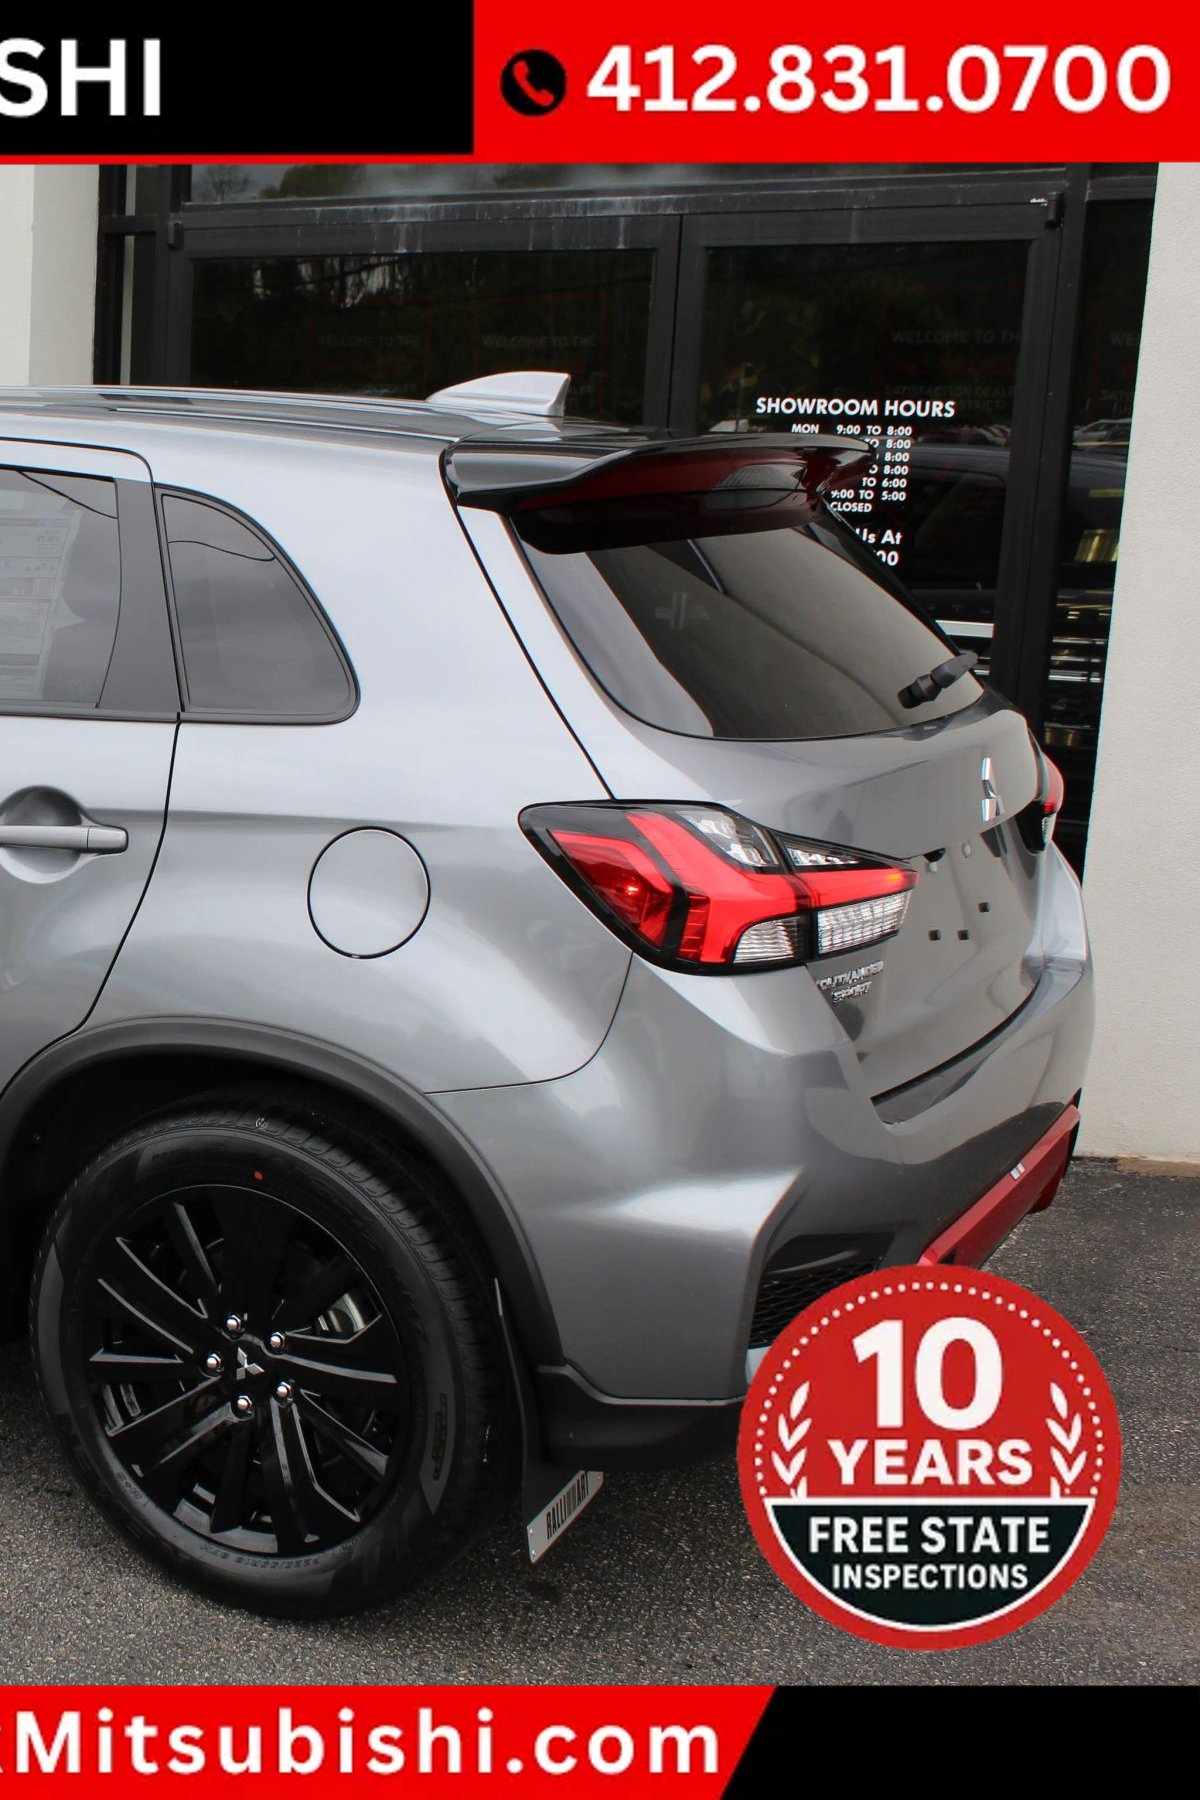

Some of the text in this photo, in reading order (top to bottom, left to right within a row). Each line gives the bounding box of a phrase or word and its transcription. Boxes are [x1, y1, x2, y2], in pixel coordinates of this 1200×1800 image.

[1000, 330, 1020, 343] TH
[755, 396, 878, 416] SHOWROOM
[884, 399, 955, 418] HOURS
[791, 423, 913, 437] MON 9:00 TO 8:00
[885, 438, 912, 449] 8:00
[884, 452, 910, 462] 8:00
[883, 465, 909, 476] 8:00
[862, 477, 907, 488] TO 6:00
[830, 489, 907, 501] 9:00 TO 5:00
[830, 501, 873, 513] CLOSED
[880, 529, 902, 545] At
